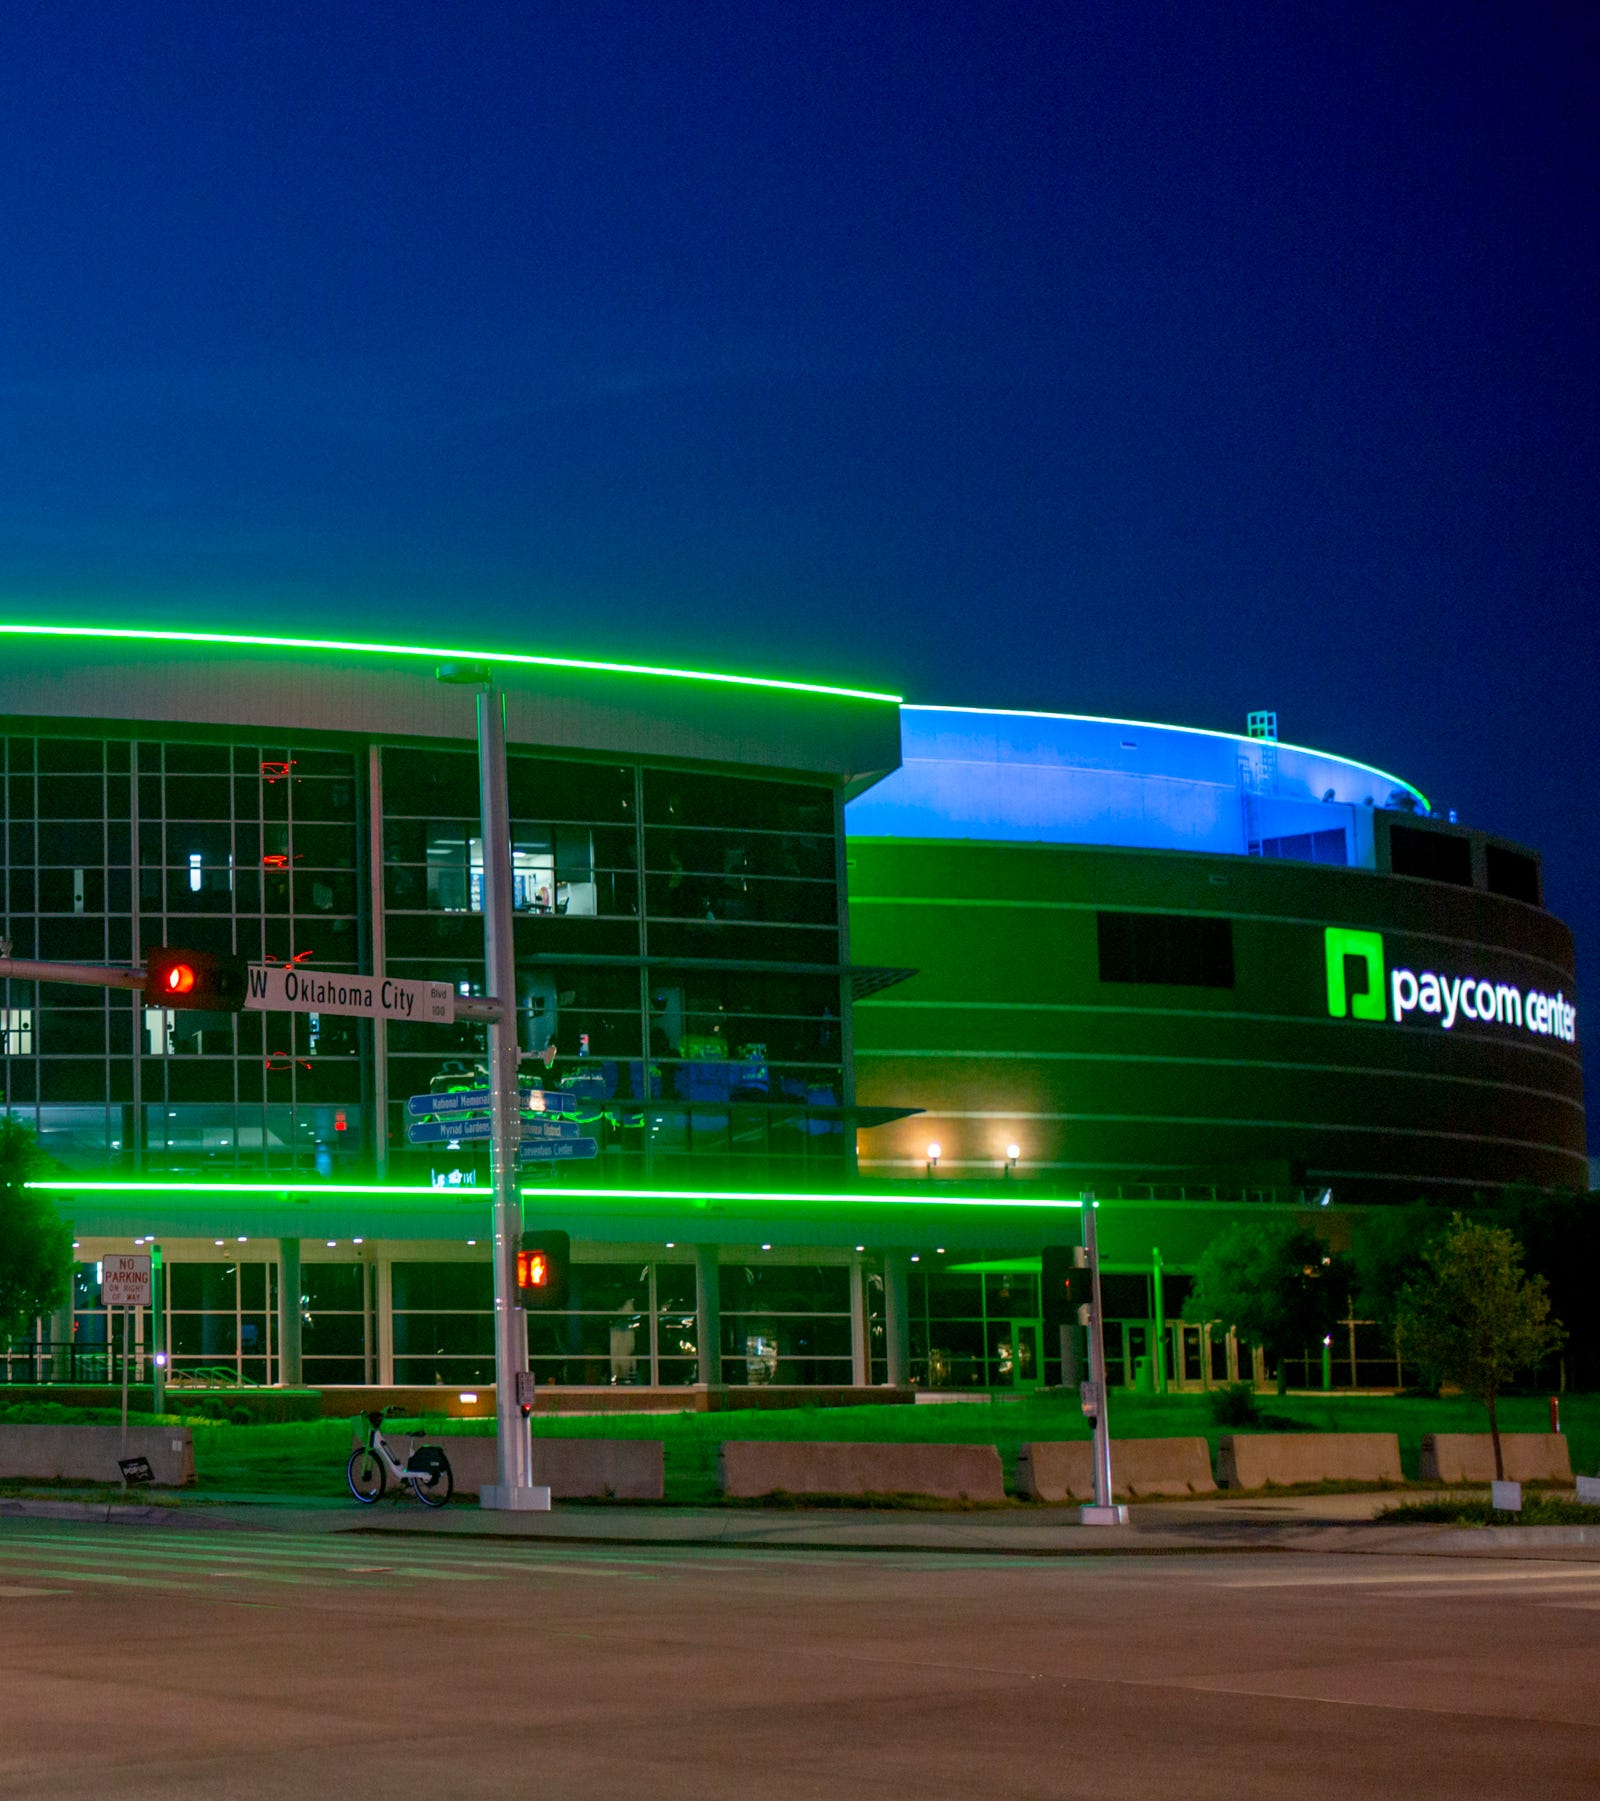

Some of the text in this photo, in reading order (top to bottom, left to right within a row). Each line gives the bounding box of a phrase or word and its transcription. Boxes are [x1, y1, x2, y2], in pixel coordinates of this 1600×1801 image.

[249, 969, 447, 1017] W Oklahoma City Blvd
[432, 1005, 446, 1017] 100
[1391, 967, 1576, 1042] paycom center
[432, 1094, 490, 1110] National Memorial
[440, 1121, 490, 1137] Myriad Gardens
[119, 1258, 135, 1270] NO
[105, 1271, 149, 1284] PARKING
